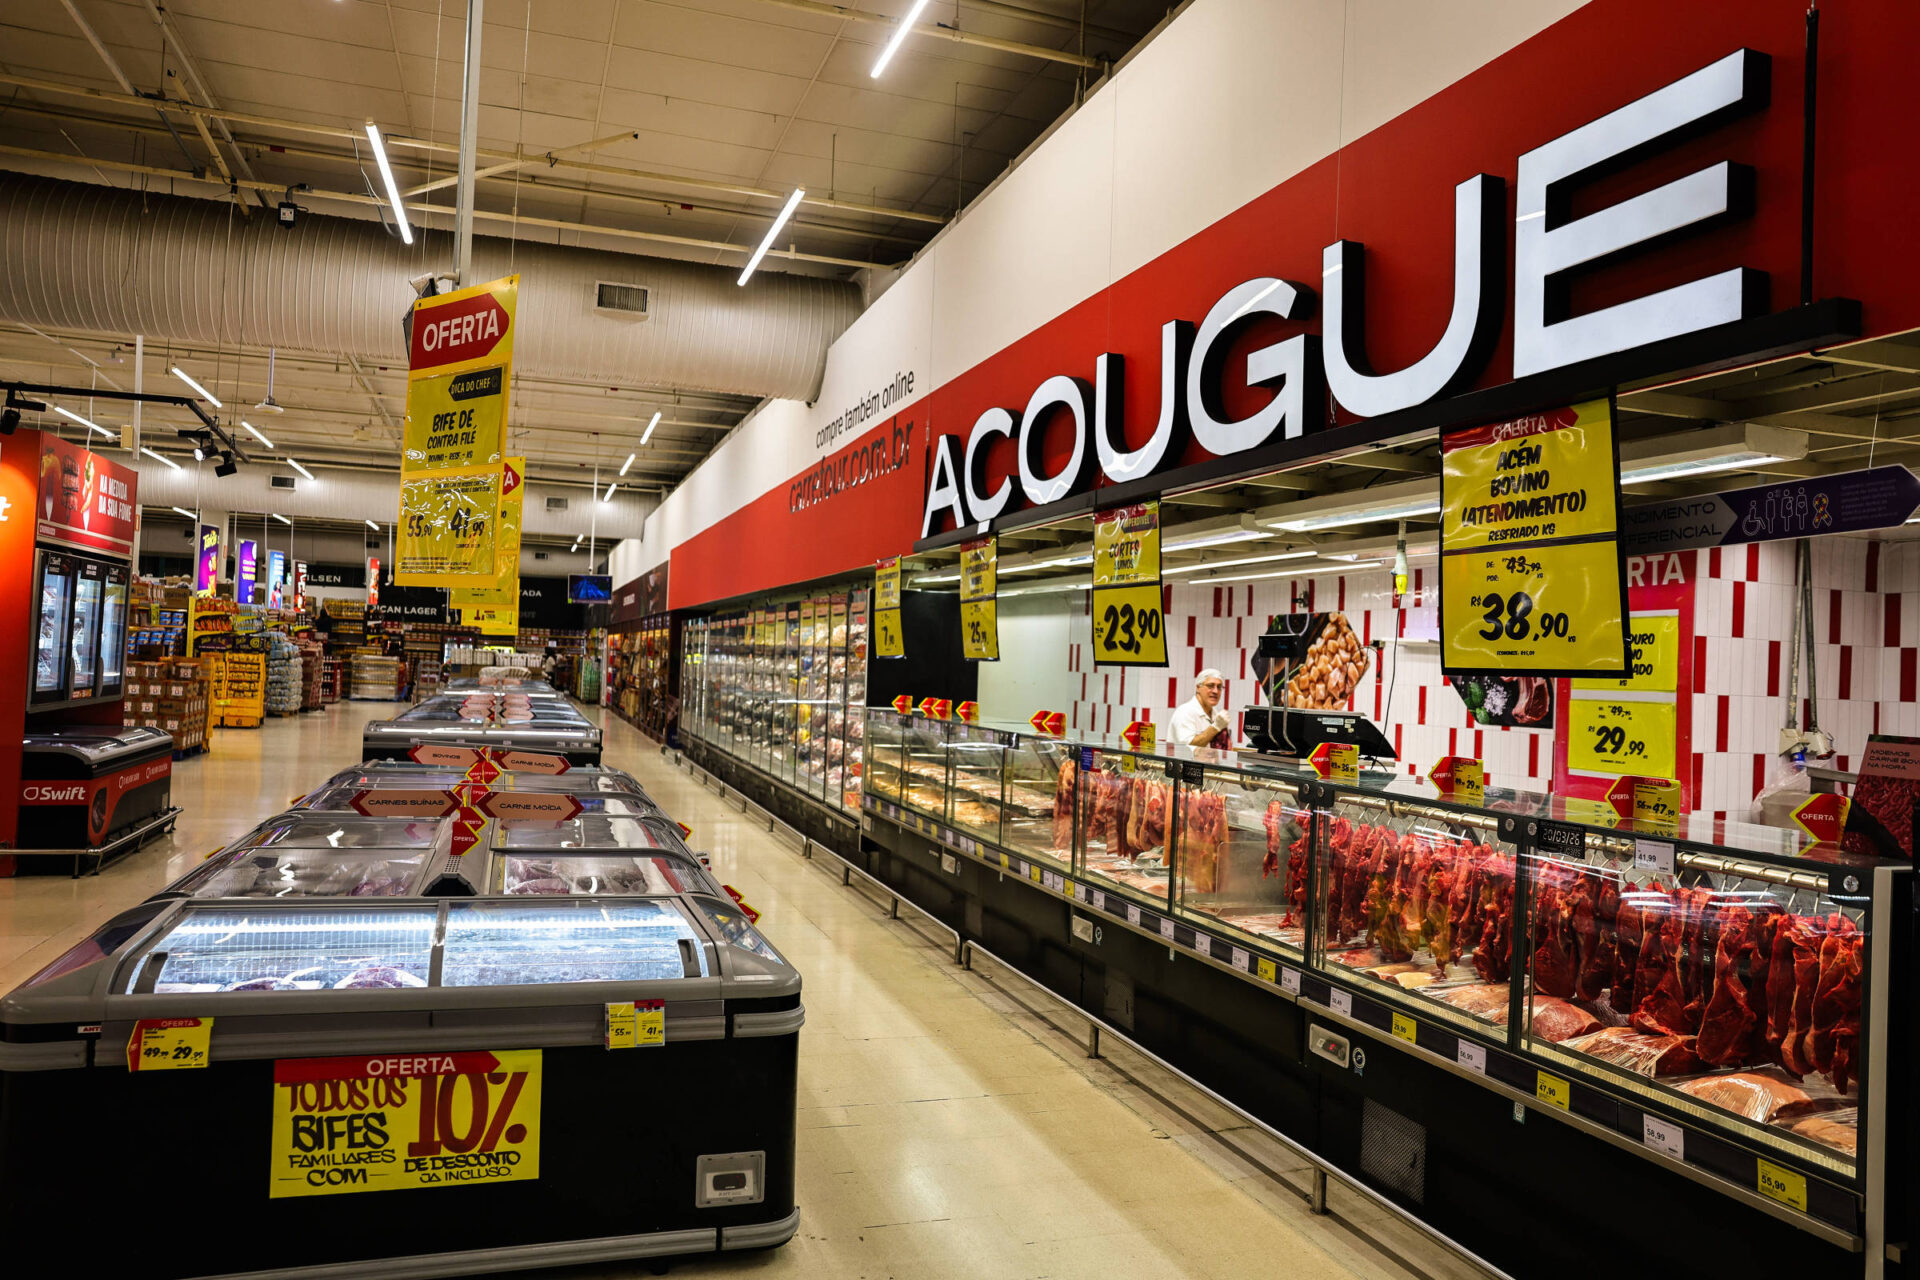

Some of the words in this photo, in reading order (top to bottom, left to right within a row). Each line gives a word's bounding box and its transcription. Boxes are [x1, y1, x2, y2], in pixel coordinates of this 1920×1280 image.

[921, 48, 1768, 538] AÇOUGUE
[423, 309, 499, 352] OFERTA
[465, 380, 475, 391] DO
[475, 377, 491, 390] CHEF
[432, 412, 457, 432] BIFE
[459, 408, 475, 429] DE
[816, 416, 843, 449] compre
[845, 390, 880, 431] também
[882, 370, 915, 409] online
[427, 433, 459, 449] CONTRA
[460, 424, 477, 445] FILÉ
[1492, 415, 1548, 441] OFERTA
[789, 416, 914, 514] carrefour.com.br
[1496, 439, 1542, 472] ACÉM
[99, 474, 108, 494] NA
[109, 477, 128, 501] MEDIDA
[1490, 470, 1550, 498] BOVINO
[98, 495, 107, 515] DA
[107, 497, 118, 518] SUA
[118, 501, 132, 522] FOME
[1461, 489, 1587, 528] (ATENDIMENTO)
[1624, 502, 1716, 525] NDIMENTO
[1488, 524, 1539, 541] RESFRIADO
[1542, 523, 1556, 535] KG
[1109, 540, 1140, 559] CORTES
[1627, 553, 1686, 588] RTA
[404, 605, 437, 616] LAGER
[1470, 595, 1482, 607] R$
[1479, 591, 1569, 642] 38,90
[1103, 603, 1160, 655] 23,90
[1593, 725, 1645, 757] 29,99
[1869, 755, 1899, 763] CARNE
[1870, 749, 1911, 757] MOEMOS
[40, 787, 86, 800] Swift
[409, 798, 445, 806] SUÍNAS
[1652, 803, 1675, 816] 47,90
[1801, 813, 1835, 821] OFERTA
[1543, 828, 1580, 846] 20/03/26
[1638, 853, 1657, 863] 41,99
[172, 1046, 203, 1060] 29,99
[366, 1056, 456, 1076] OFERTA
[280, 1077, 370, 1113] TODOS
[372, 1075, 408, 1109] OS
[1539, 1084, 1556, 1096] 47,90
[407, 1071, 529, 1157] 10%
[291, 1112, 390, 1152] BIFES
[1646, 1127, 1666, 1142] 58,99
[288, 1148, 397, 1168] FAMILIARES
[404, 1157, 429, 1173] DE
[430, 1150, 521, 1171] DESCONTO
[306, 1168, 368, 1187] COM
[1761, 1174, 1786, 1192] 55,90
